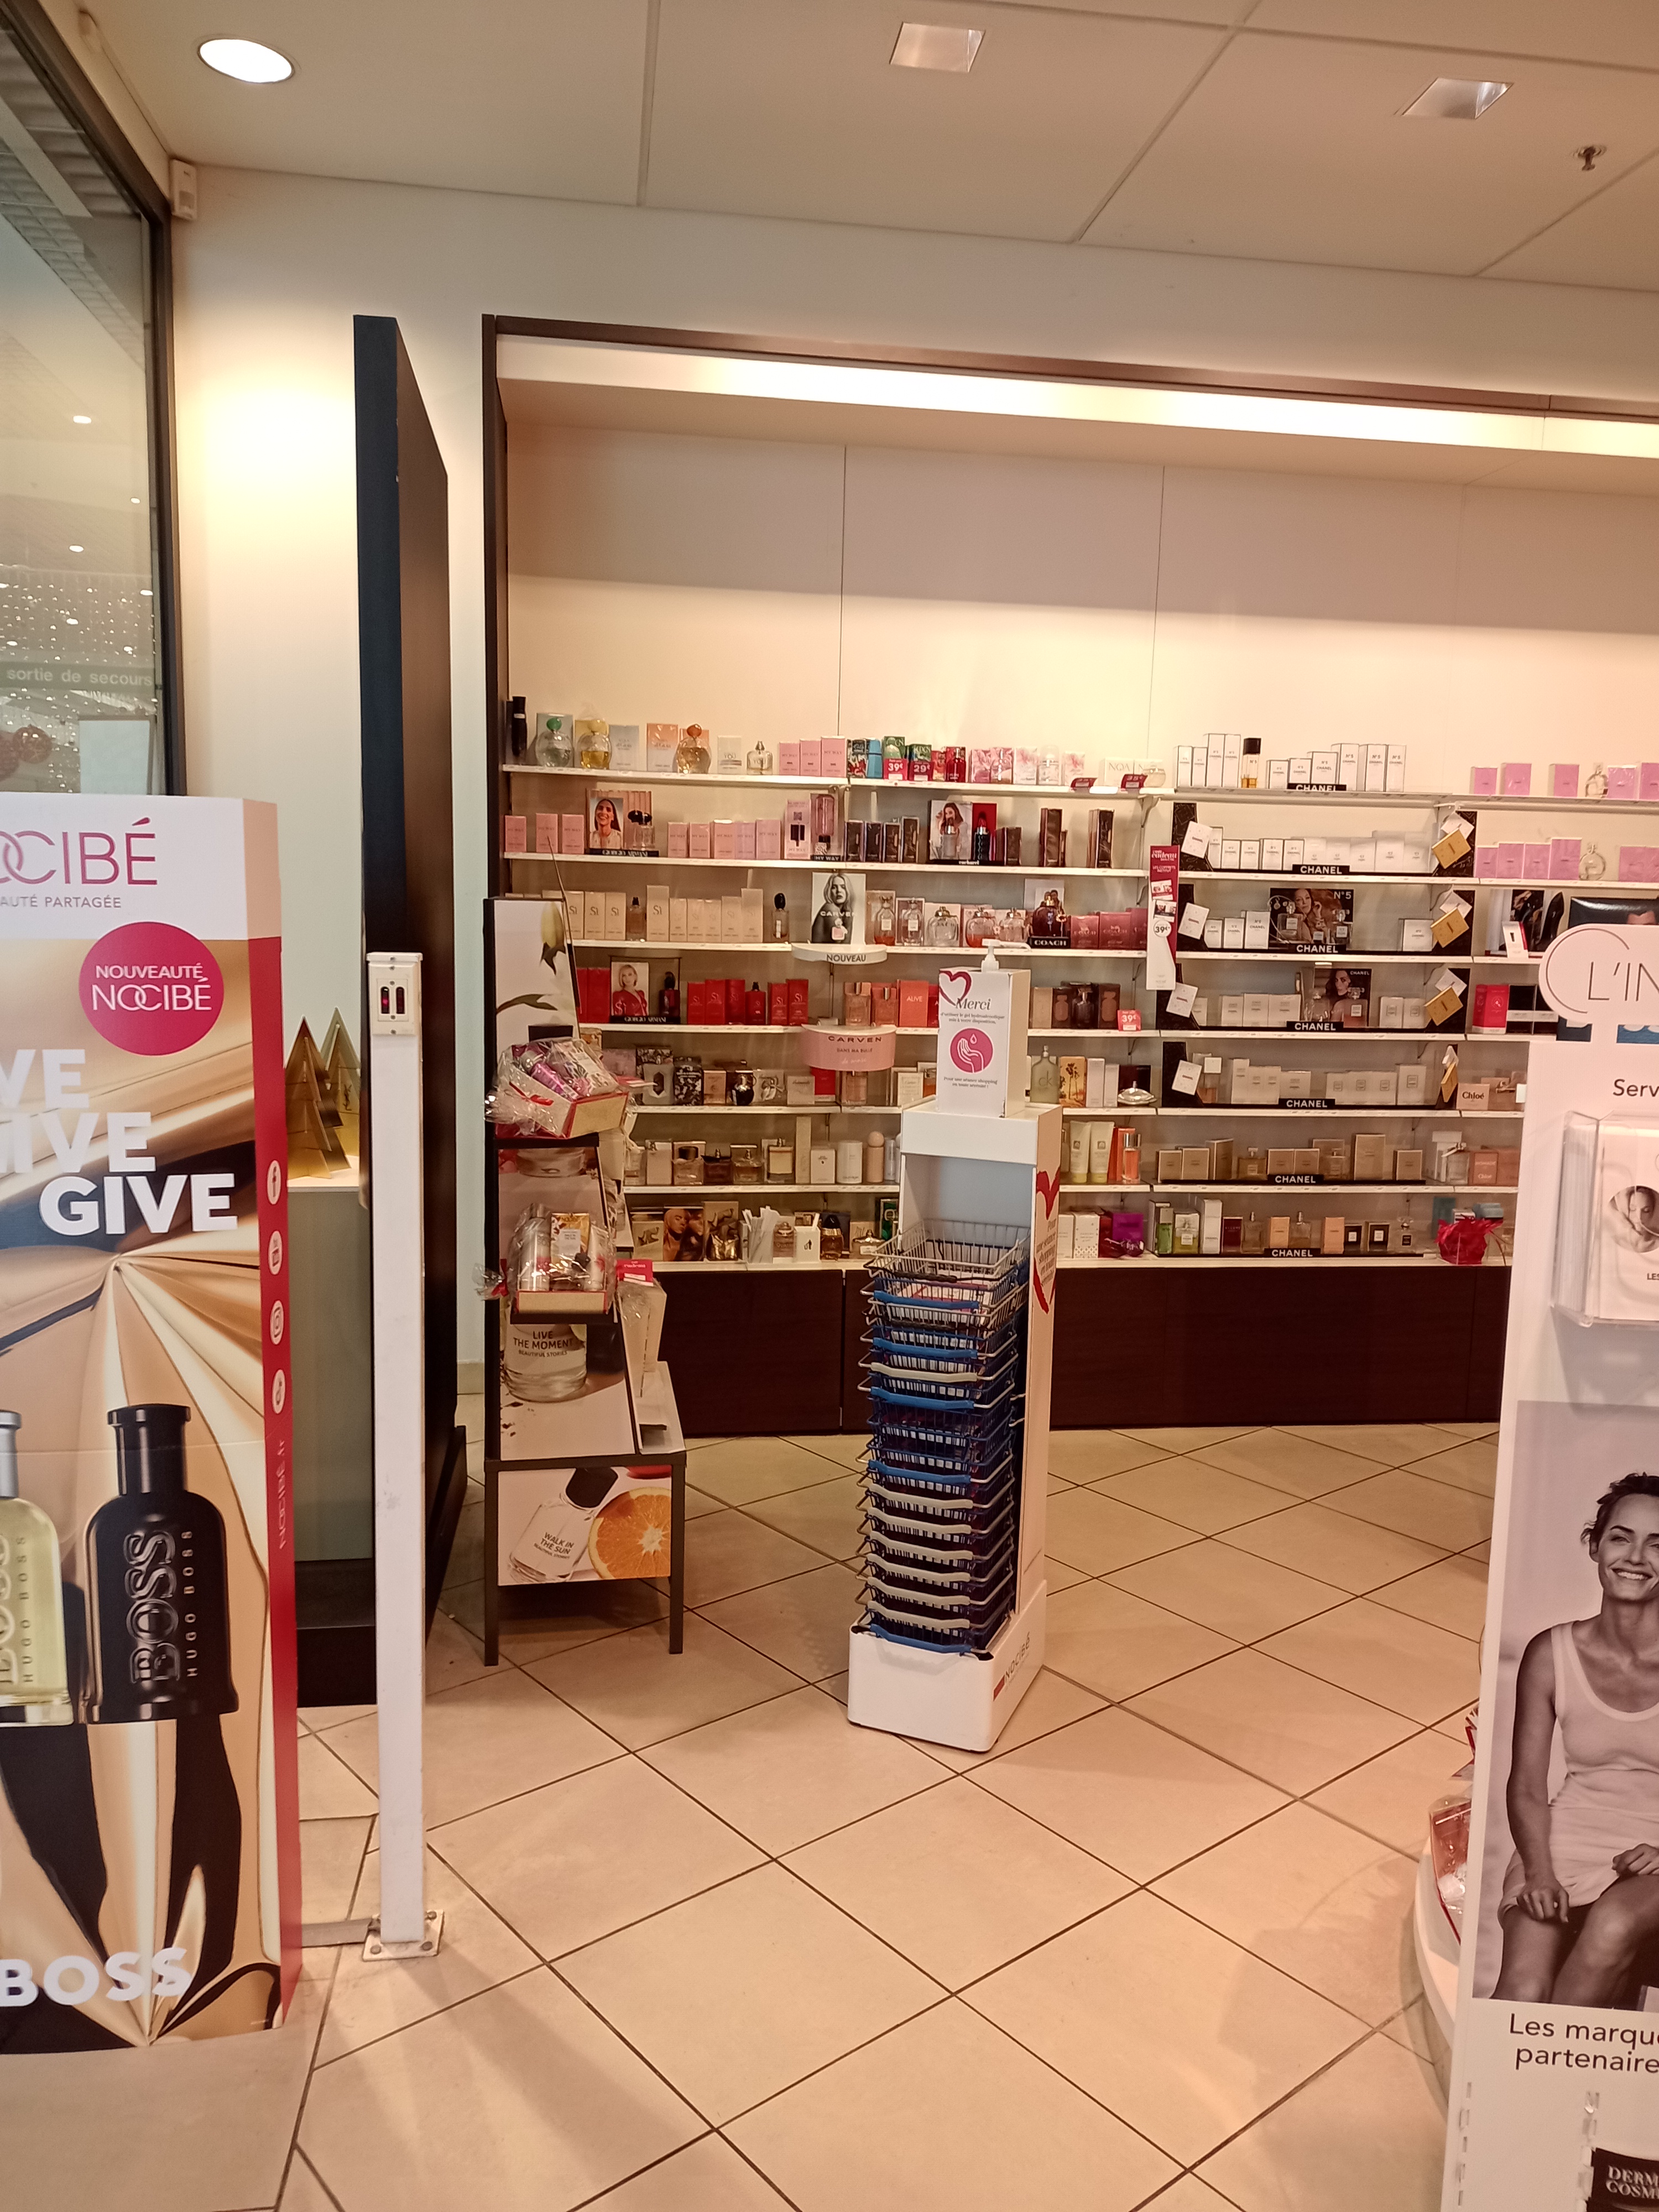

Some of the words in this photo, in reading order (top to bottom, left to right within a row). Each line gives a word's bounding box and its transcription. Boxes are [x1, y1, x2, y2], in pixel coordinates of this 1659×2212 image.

[7, 667, 53, 681] sortie
[62, 669, 81, 684] de
[90, 671, 152, 686] secours
[1300, 865, 1343, 874] CHANEL
[45, 895, 121, 909] PARTAGÉE
[1333, 891, 1352, 899] N°5
[1296, 945, 1339, 953] CHANEL
[826, 953, 867, 962] NOUVEAU
[96, 963, 204, 979] NOUVEAUTÉ
[92, 977, 212, 1011] NOCIBÉ
[955, 998, 991, 1010] Merci
[1121, 1014, 1136, 1022] 39€
[1294, 1022, 1337, 1031] CHANEL
[1462, 1091, 1485, 1100] Chloé
[1286, 1099, 1328, 1108] CHANEL
[0, 1112, 156, 1173] IVE
[1275, 1175, 1316, 1183] CHANEL
[39, 1173, 238, 1237] GIVE
[533, 1331, 553, 1339] LIVE
[513, 1337, 529, 1349] THE
[532, 1338, 572, 1350] MOMENT
[540, 1537, 554, 1550] THE
[554, 1546, 571, 1554] SUN
[545, 1532, 565, 1546] WALK
[180, 1530, 196, 1595] BOSS
[123, 1530, 180, 1684] BOSS
[184, 1613, 199, 1678] HUGO
[0, 1947, 192, 2007] BOSS
[1509, 2013, 1554, 2037] Les
[1566, 2023, 1659, 2050] marqu
[1515, 2047, 1659, 2074] partenaire
